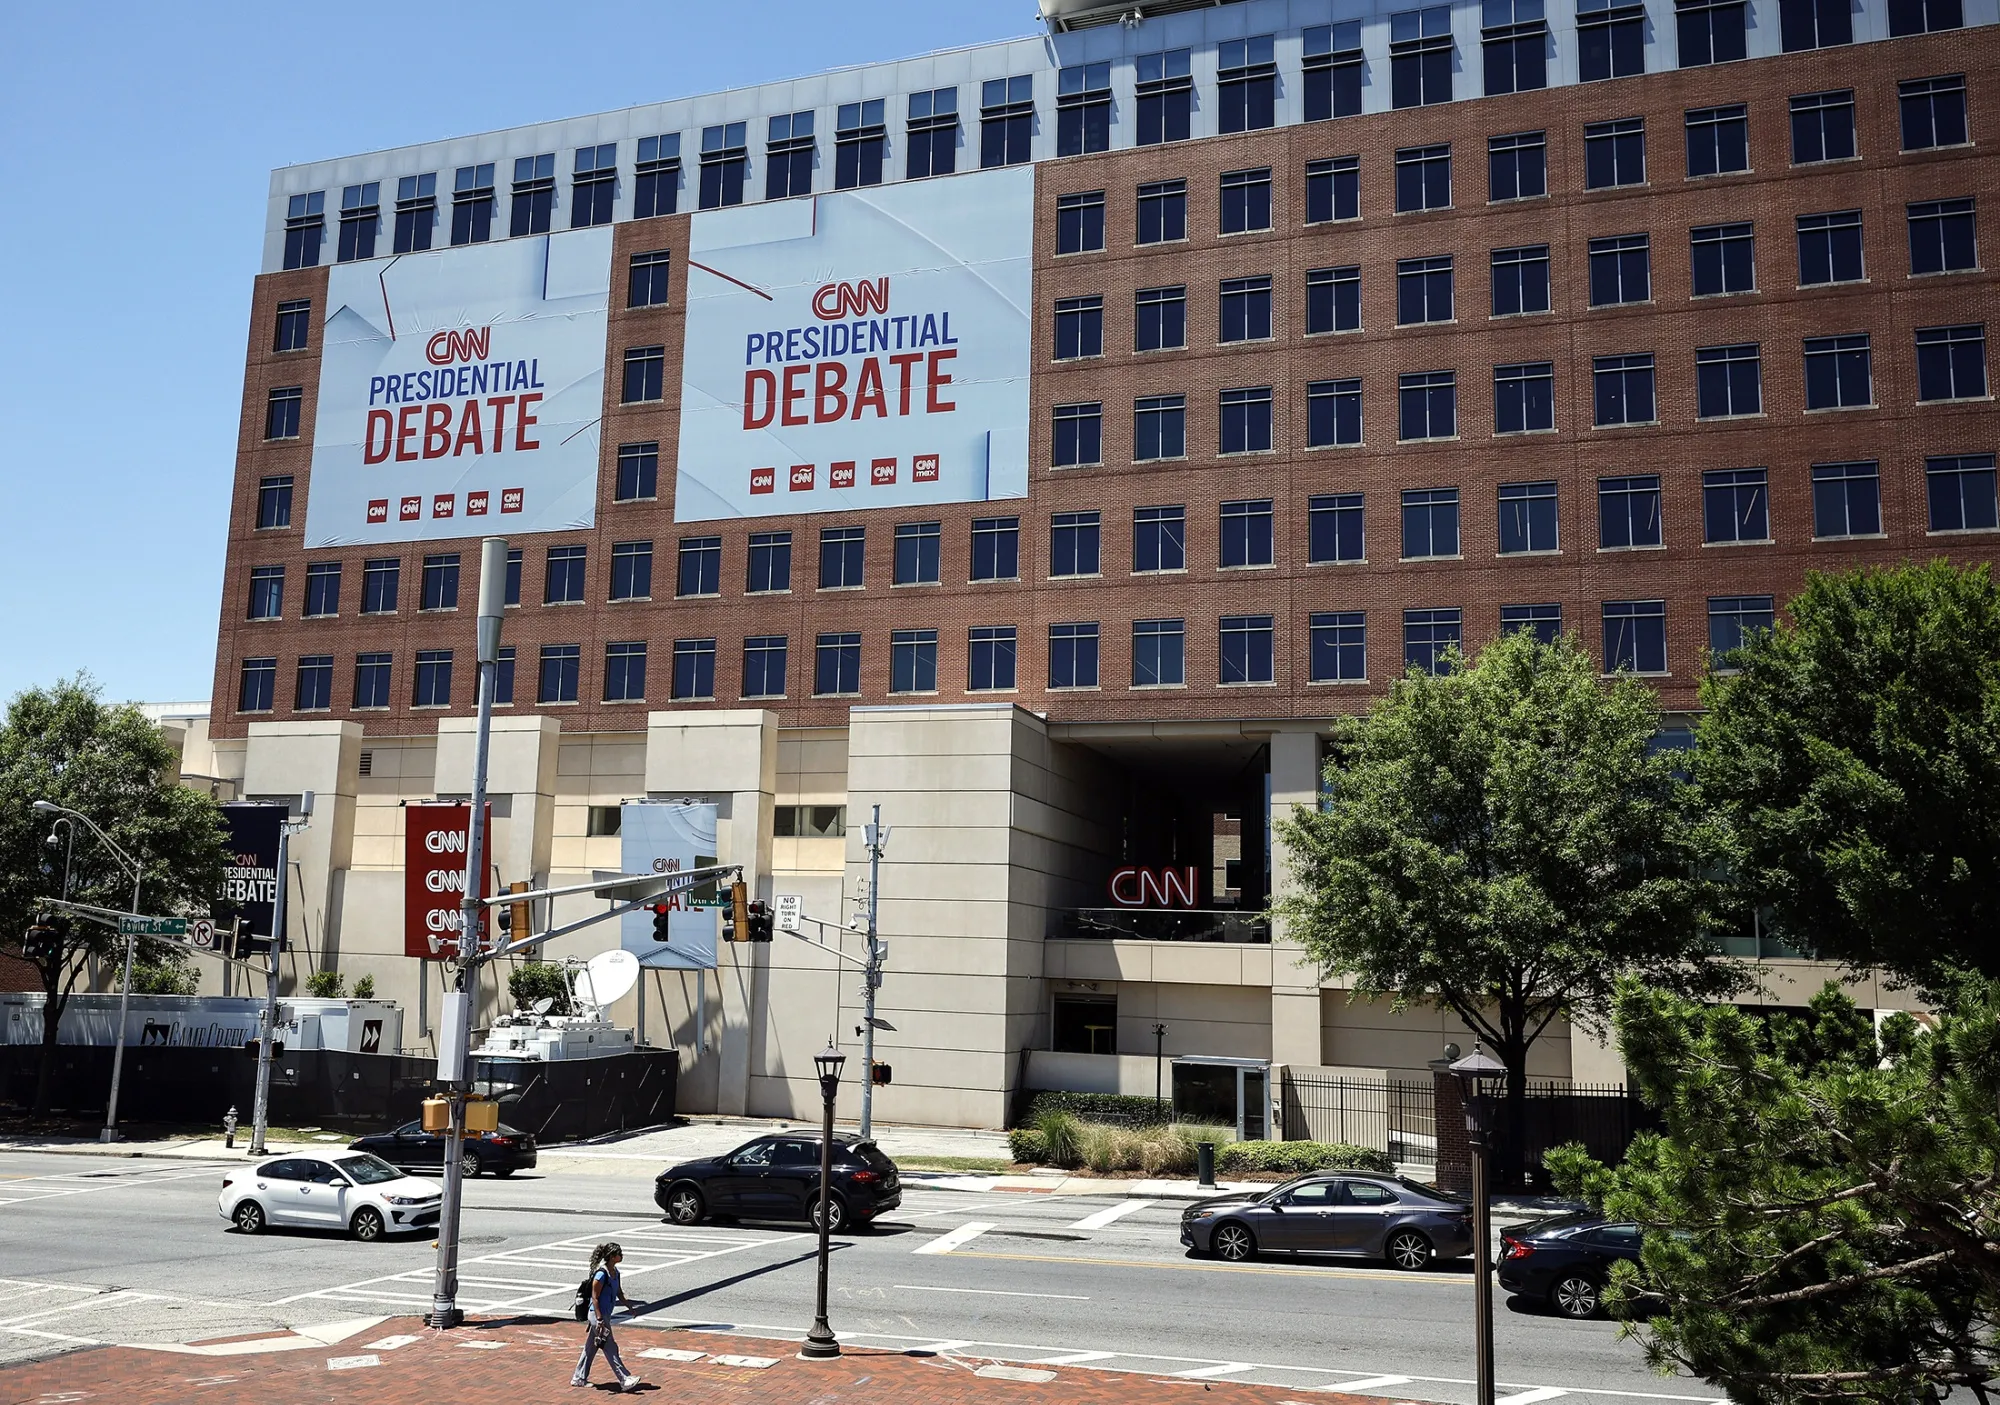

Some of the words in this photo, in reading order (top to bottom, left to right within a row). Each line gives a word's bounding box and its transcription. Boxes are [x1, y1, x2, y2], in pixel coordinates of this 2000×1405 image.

[812, 277, 889, 320] CNN
[426, 326, 490, 365] CNN
[746, 312, 958, 366] PRESIDENTIAL
[369, 359, 544, 405] PRESIDENTIAL
[743, 349, 957, 430] DEBATE
[363, 393, 543, 465] DEBATE
[873, 465, 895, 478] CNN
[915, 460, 936, 470] CNN
[752, 475, 772, 487] CNN
[832, 469, 853, 481] CNN
[469, 498, 487, 509] CNN
[504, 492, 521, 503] CNN
[369, 506, 386, 516] CNN
[435, 501, 452, 512] CNN
[425, 830, 465, 853] CNN
[236, 853, 257, 866] CNN
[653, 858, 680, 872] CNN
[222, 866, 276, 880] RESIDENTIAL
[425, 870, 465, 893] CNN
[1106, 866, 1198, 909] CNN
[121, 920, 149, 933] Fowler
[153, 920, 162, 931] St
[426, 909, 463, 932] CNN
